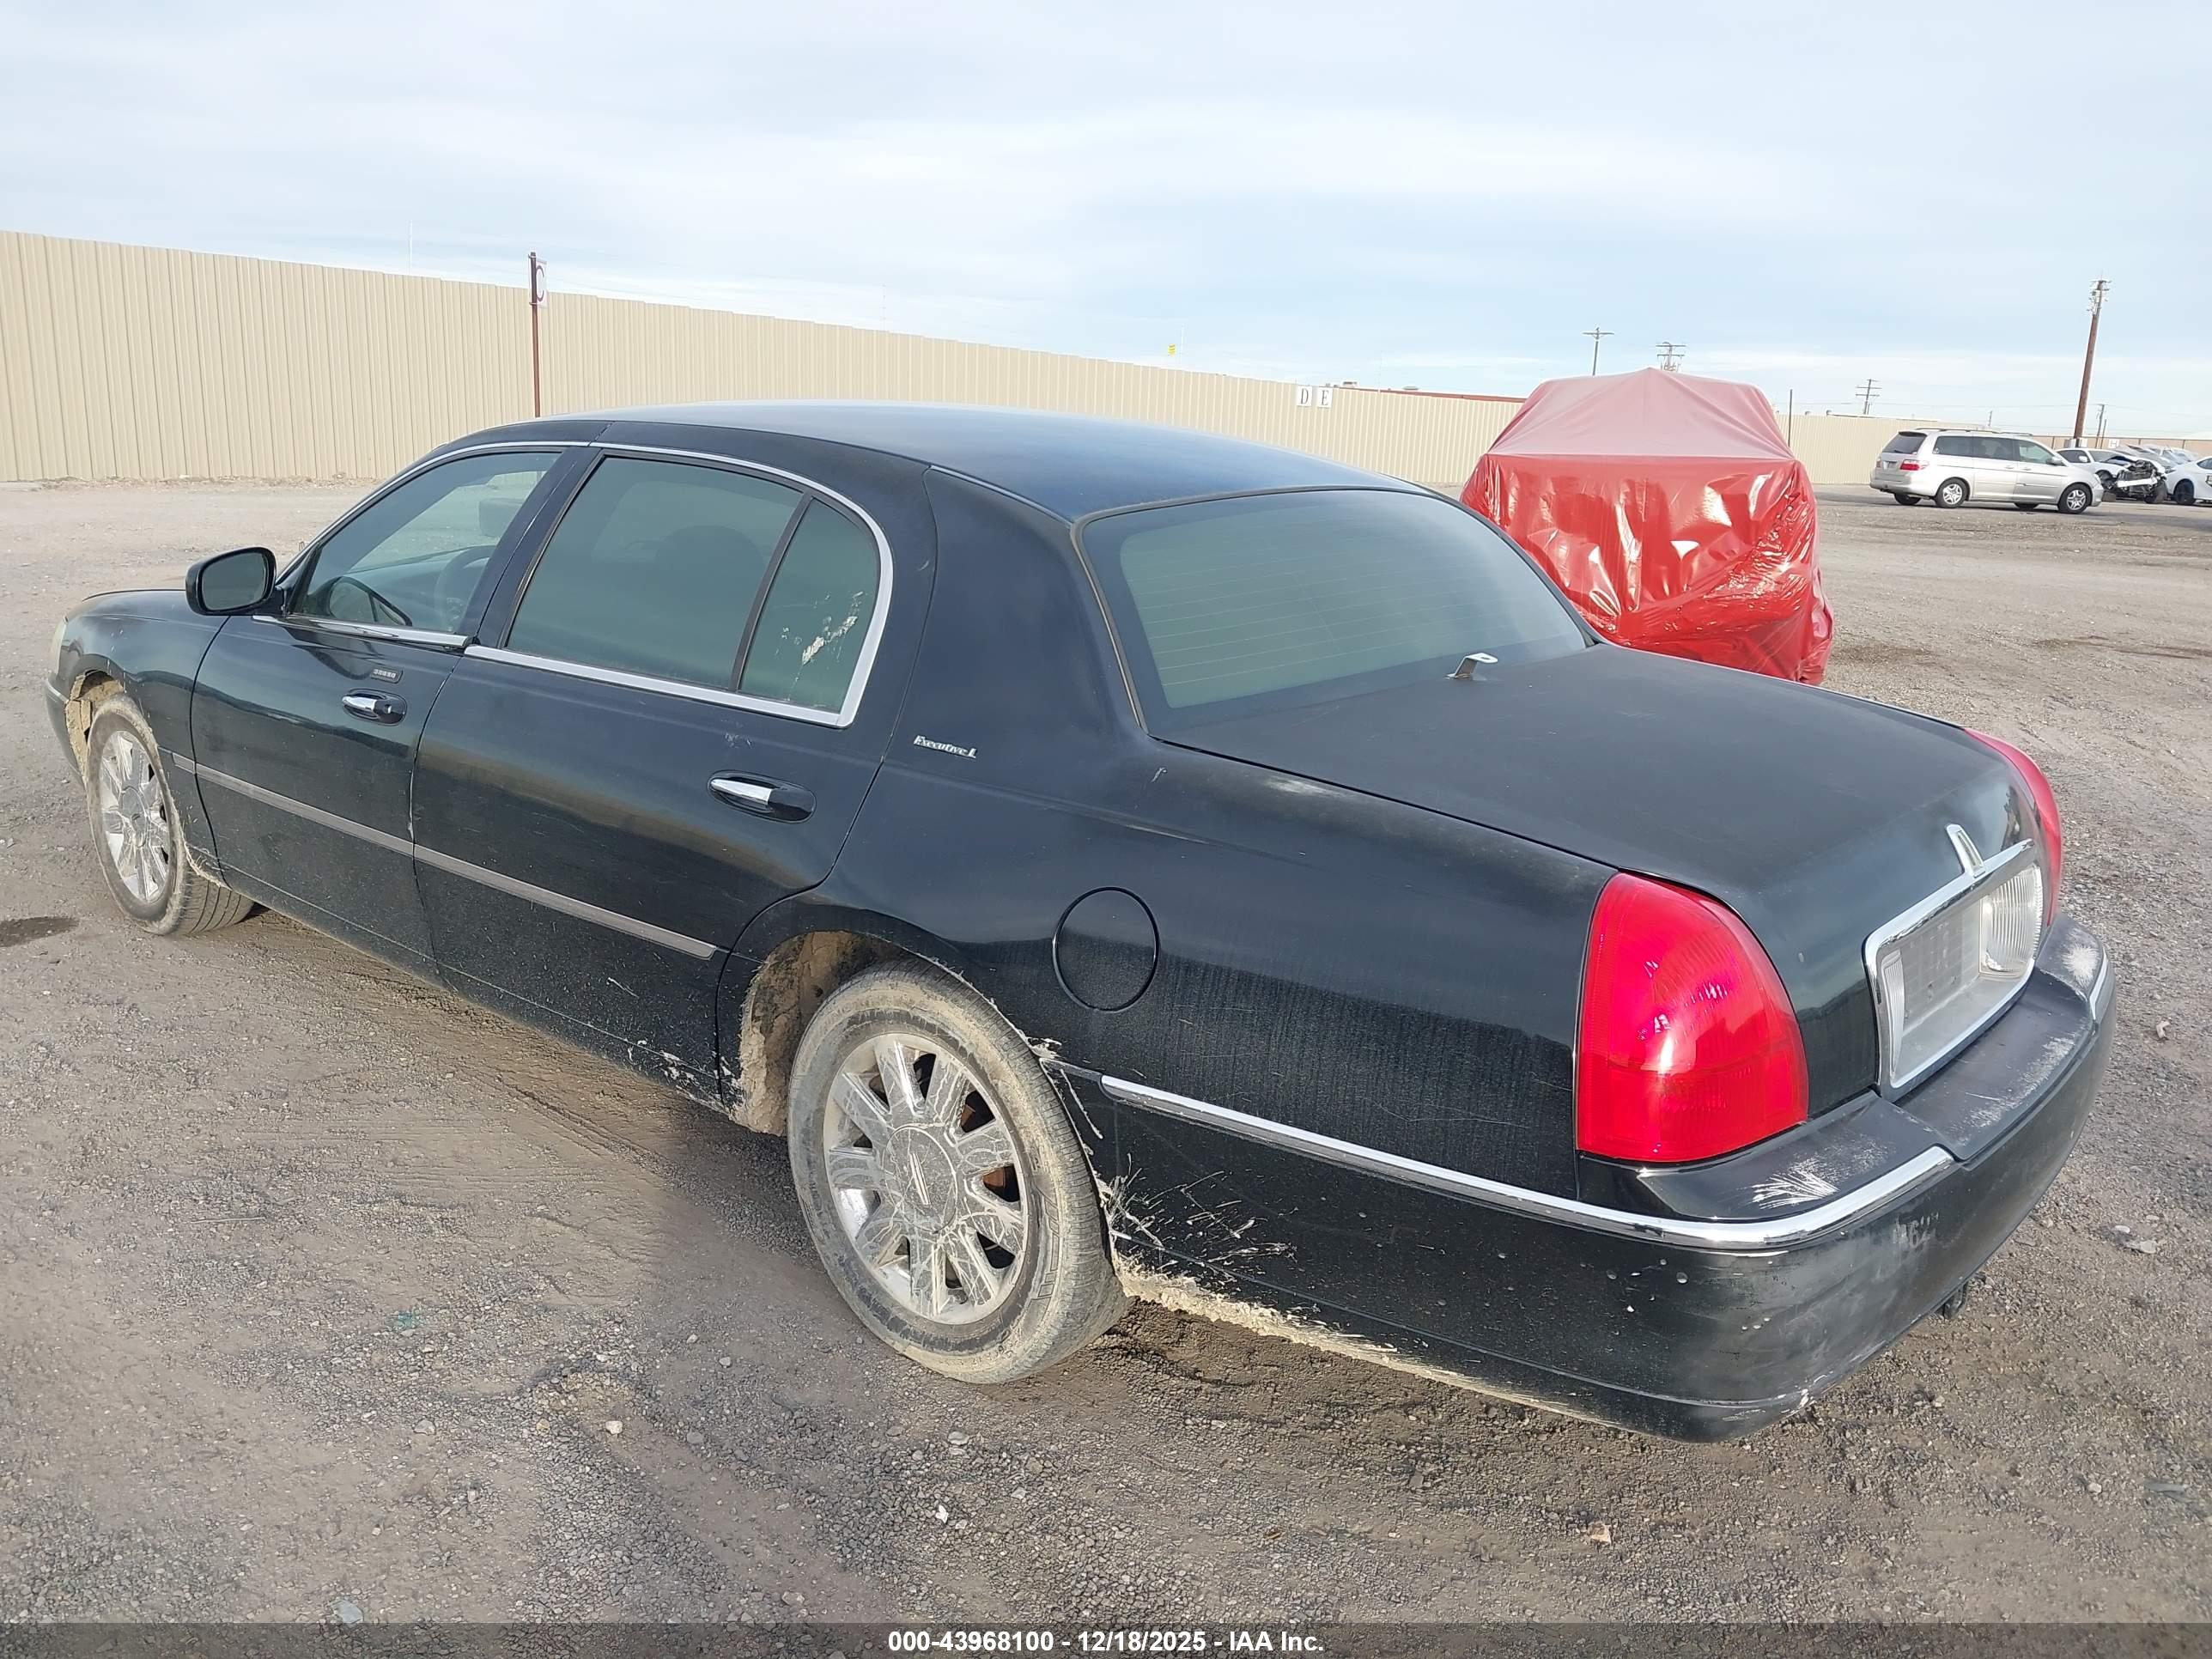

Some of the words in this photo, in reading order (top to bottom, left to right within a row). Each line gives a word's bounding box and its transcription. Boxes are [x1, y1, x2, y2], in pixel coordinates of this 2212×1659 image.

[1300, 387, 1310, 404] D
[1321, 389, 1329, 406] E
[913, 735, 969, 757] Executive
